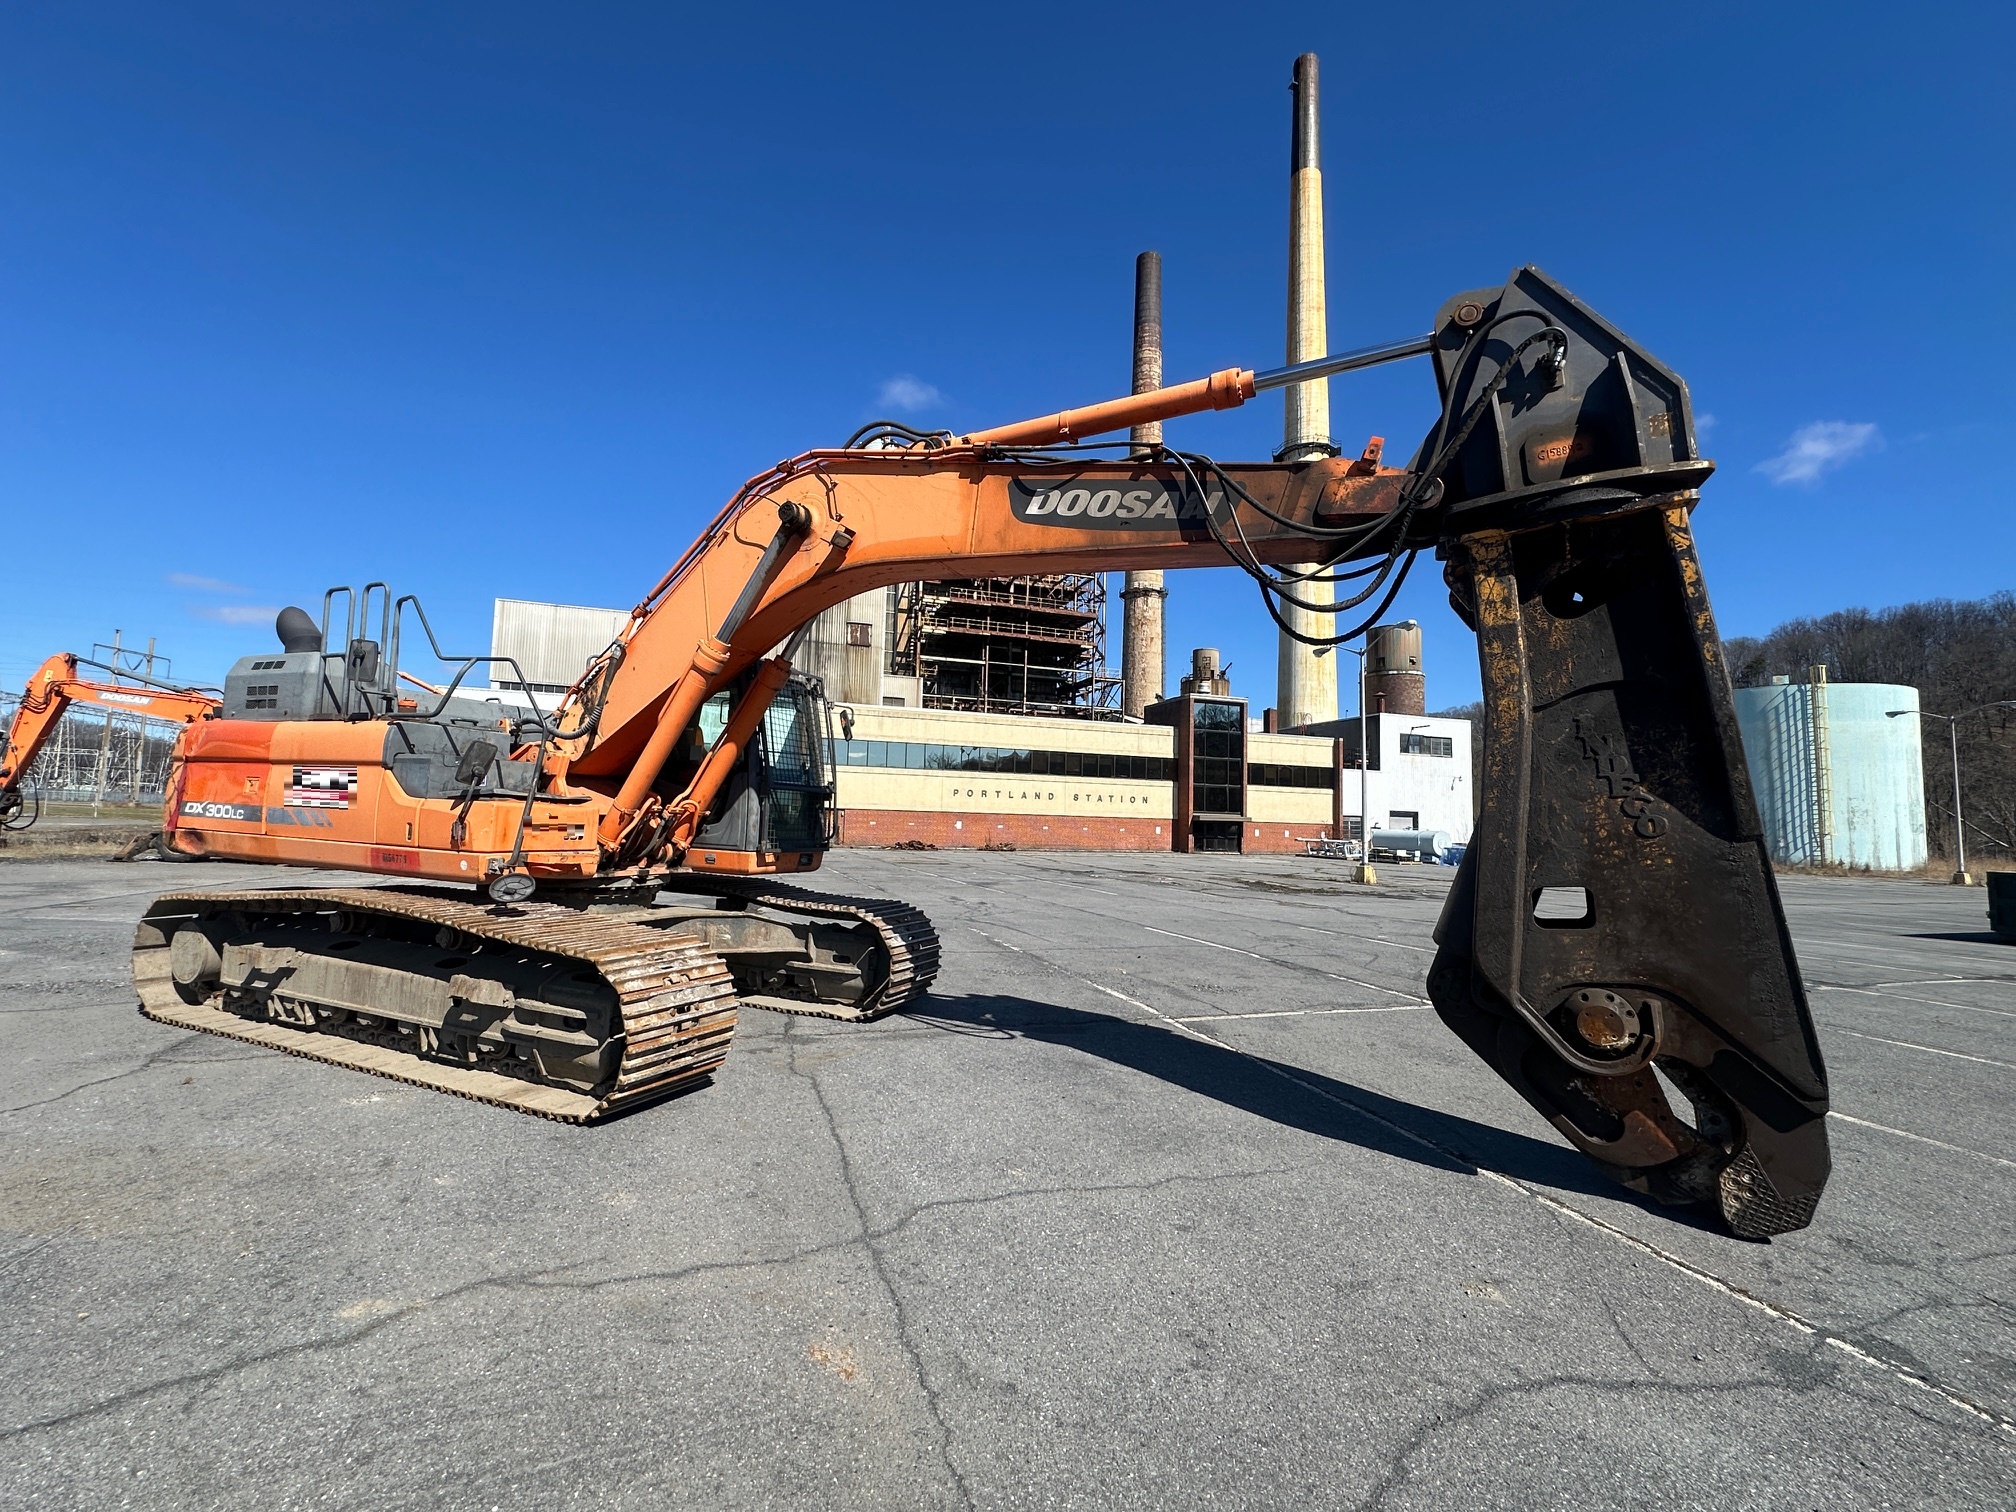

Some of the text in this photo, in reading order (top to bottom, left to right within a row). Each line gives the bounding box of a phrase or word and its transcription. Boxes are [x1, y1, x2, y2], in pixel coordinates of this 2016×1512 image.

[1025, 488, 1224, 520] DOOSAN
[100, 692, 151, 705] DOOSAN
[953, 788, 1149, 804] PORTLAND STATION
